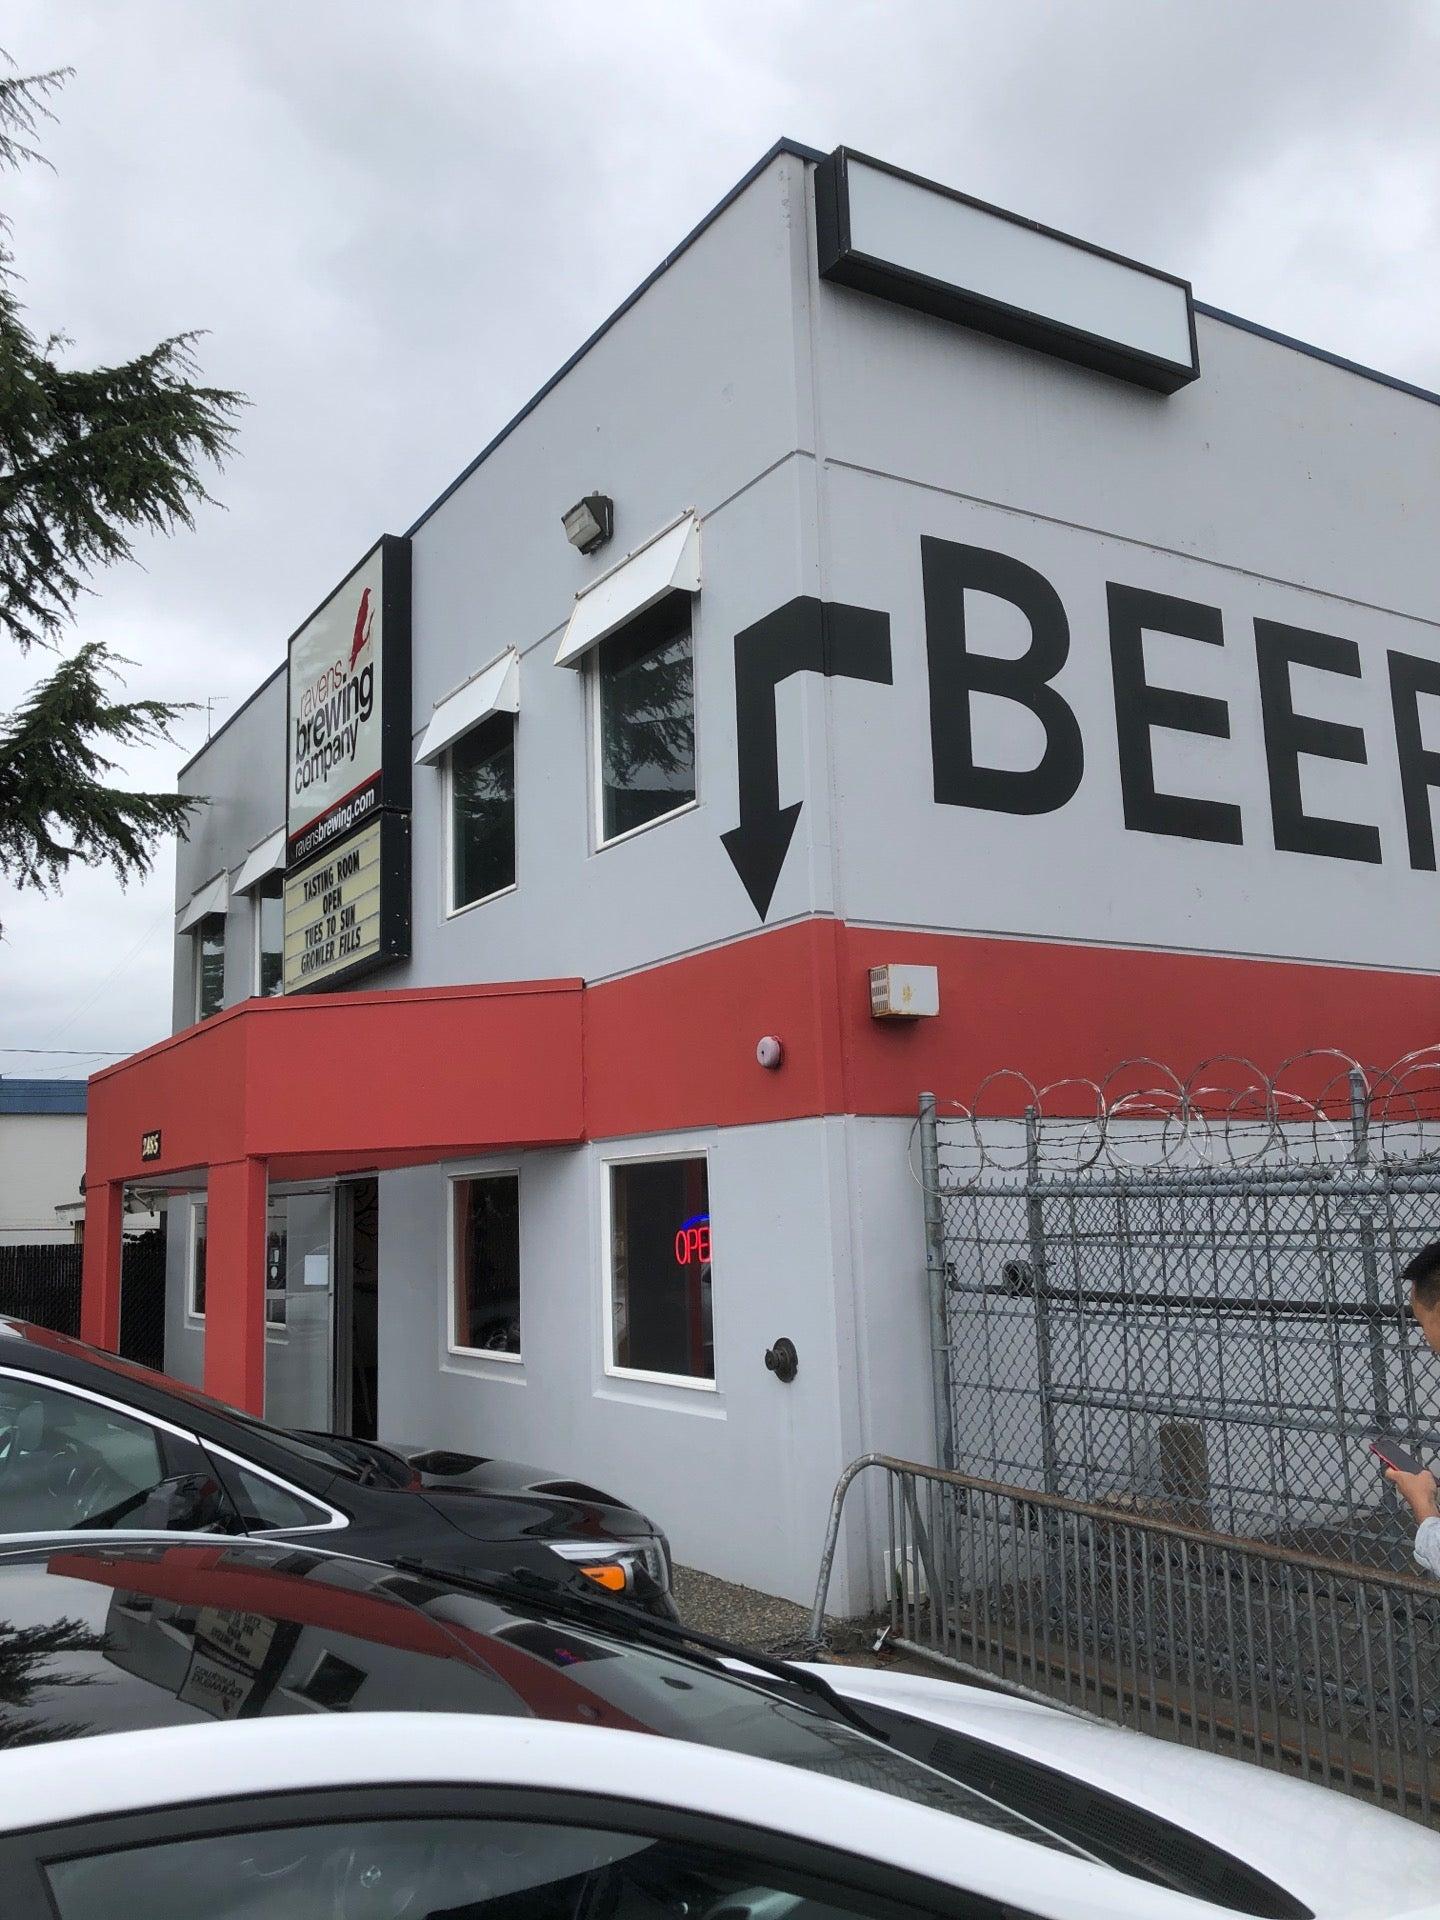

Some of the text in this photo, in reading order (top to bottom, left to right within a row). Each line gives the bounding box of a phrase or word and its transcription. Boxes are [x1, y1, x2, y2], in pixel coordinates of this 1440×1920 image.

[296, 662, 374, 764] brewing
[300, 660, 342, 721] ravens
[295, 718, 359, 794] company
[295, 789, 375, 858] ravensbrewing.com
[304, 850, 360, 901] TASTING ROOM
[323, 887, 342, 915] OPEN
[301, 927, 362, 975] GROWLER FILLS
[305, 904, 356, 949] TUES TO SUN
